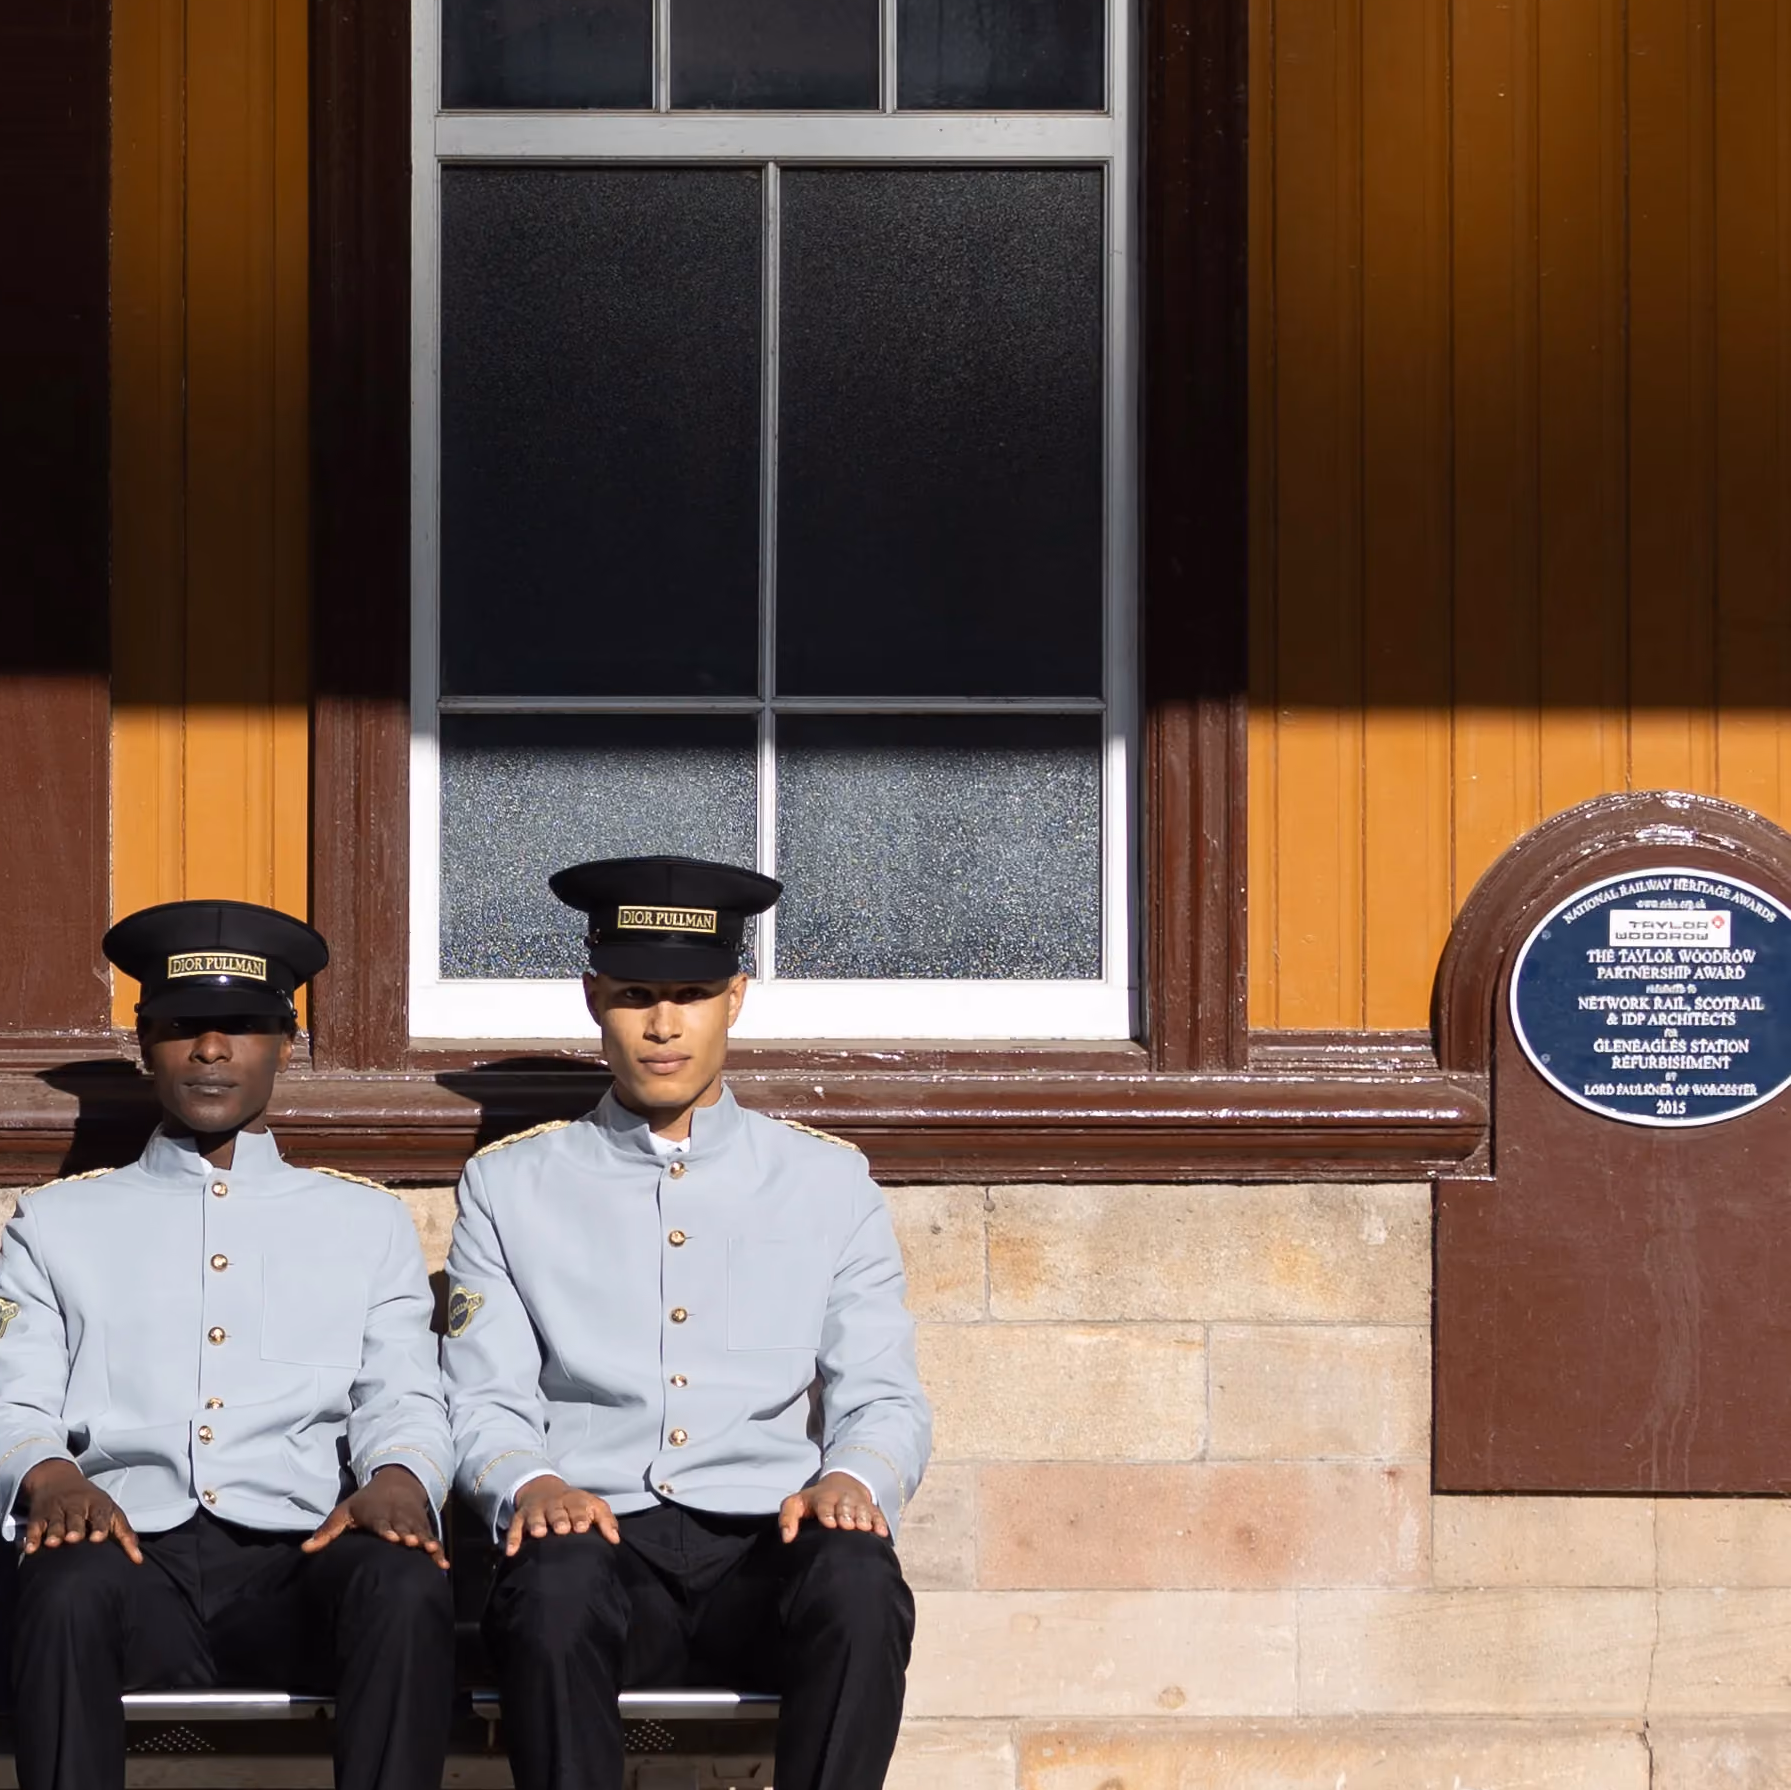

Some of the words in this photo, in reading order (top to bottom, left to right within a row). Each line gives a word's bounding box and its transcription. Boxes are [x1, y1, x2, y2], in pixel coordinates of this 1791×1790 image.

[1562, 889, 1619, 924] NATIONAL
[1619, 878, 1672, 897] RAILWAY
[1673, 878, 1731, 899] HERITAGE
[1731, 891, 1777, 923] AWARDS
[623, 911, 653, 924] DIOR
[656, 912, 712, 928] PULLMAN
[1628, 921, 1708, 929] TAYLOR
[1615, 932, 1708, 940] WOODROW
[1586, 949, 1616, 963] THE
[1618, 949, 1675, 963] TAYLOR
[1678, 949, 1756, 963] WOODROW
[173, 958, 203, 973] DIOR
[205, 957, 262, 974] PULLMAN
[1596, 965, 1692, 979] PARTNERSHIP
[1693, 965, 1745, 979] AWARD
[1578, 996, 1650, 1010] NETWORK
[1694, 996, 1765, 1010] SCOTRAIL
[1606, 1012, 1618, 1025] &
[1621, 1012, 1646, 1025] IDP
[1647, 1012, 1736, 1026] ARCHITECTS
[1593, 1038, 1687, 1053] GLENEAGLES
[1690, 1038, 1749, 1053] STATION
[1611, 1055, 1732, 1069] REFURBISHMENT
[1584, 1083, 1615, 1096] LORD
[1616, 1083, 1674, 1096] FAULKNER
[1675, 1083, 1690, 1096] OF
[1692, 1083, 1758, 1096] WORCESTER
[1656, 1099, 1686, 1114] 2015
